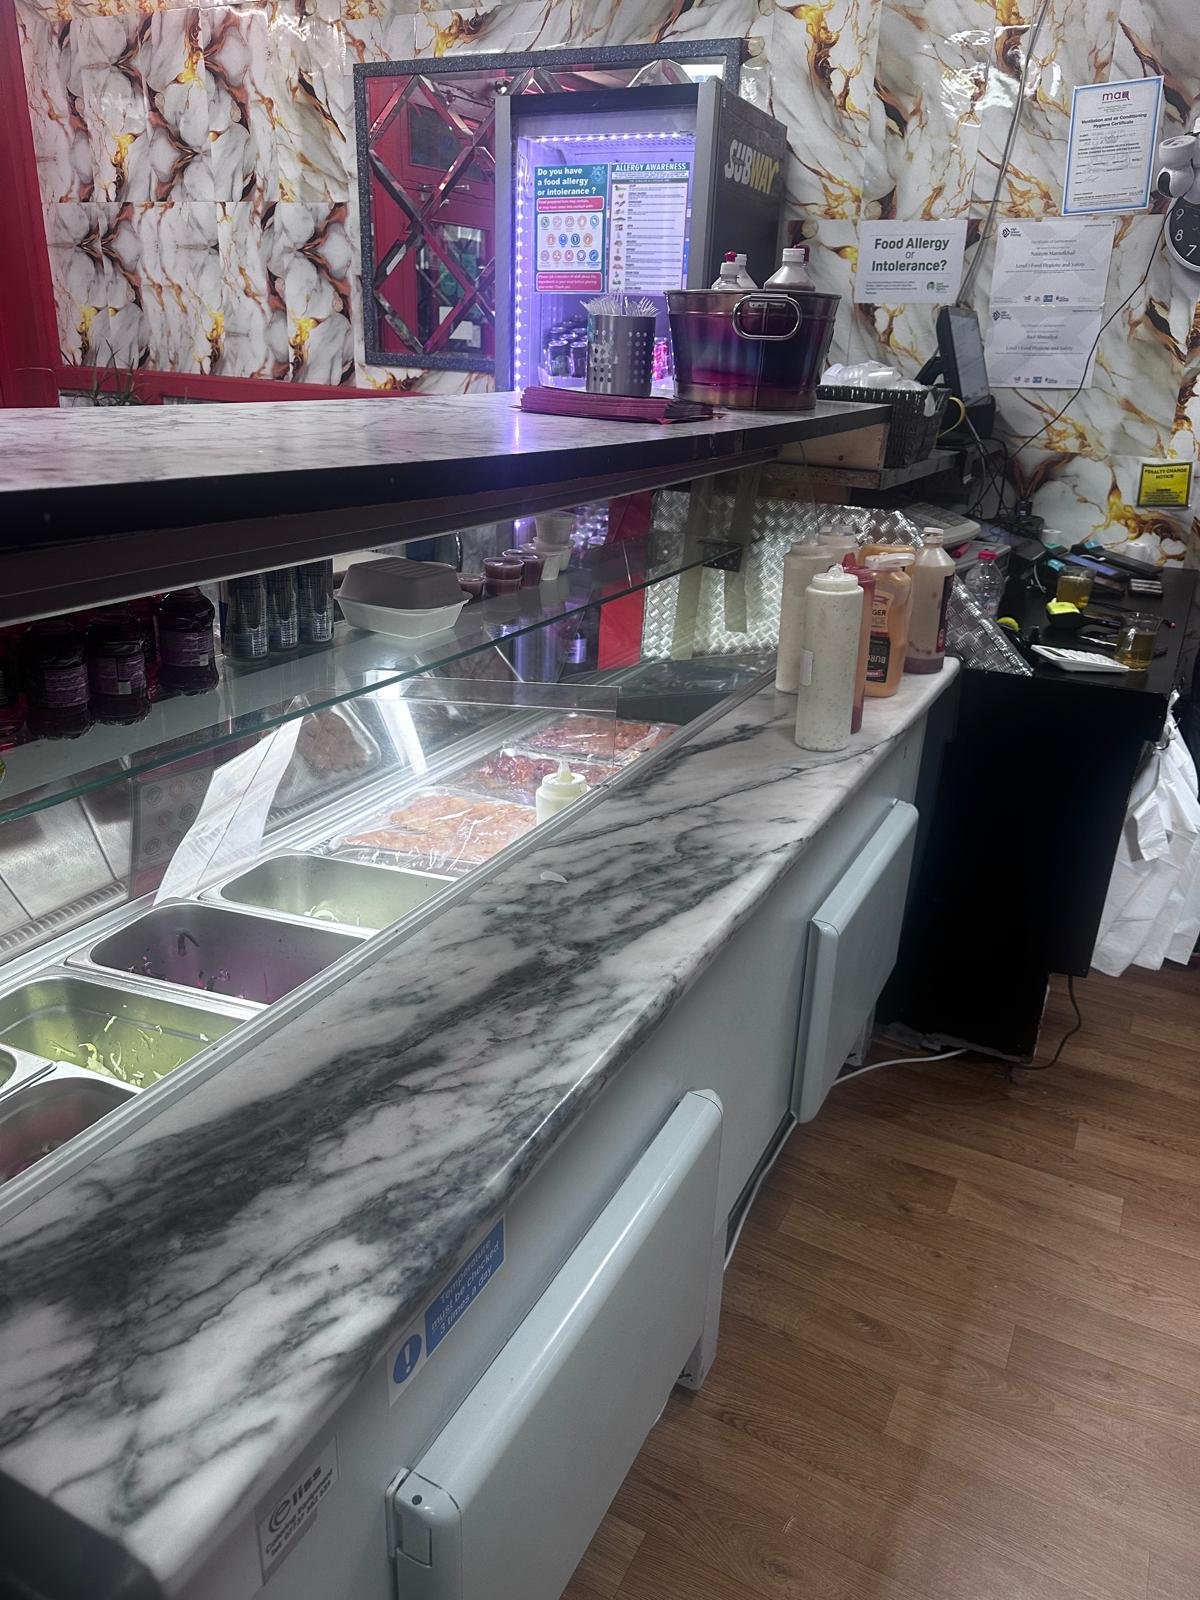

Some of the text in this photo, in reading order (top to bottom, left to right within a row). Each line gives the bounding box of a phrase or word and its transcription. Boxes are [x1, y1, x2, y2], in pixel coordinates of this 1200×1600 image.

[549, 168, 562, 178] you
[724, 139, 780, 195] SUBWAY
[562, 178, 588, 187] allergy
[547, 188, 590, 196] intolerance
[1176, 208, 1184, 220] 9
[1174, 229, 1184, 241] 8
[874, 238, 950, 251] Food Allergy
[1186, 244, 1197, 256] 7
[872, 260, 947, 272] Intolerance?
[467, 1241, 500, 1288] checked
[447, 1292, 470, 1325] times
[478, 1264, 493, 1286] day
